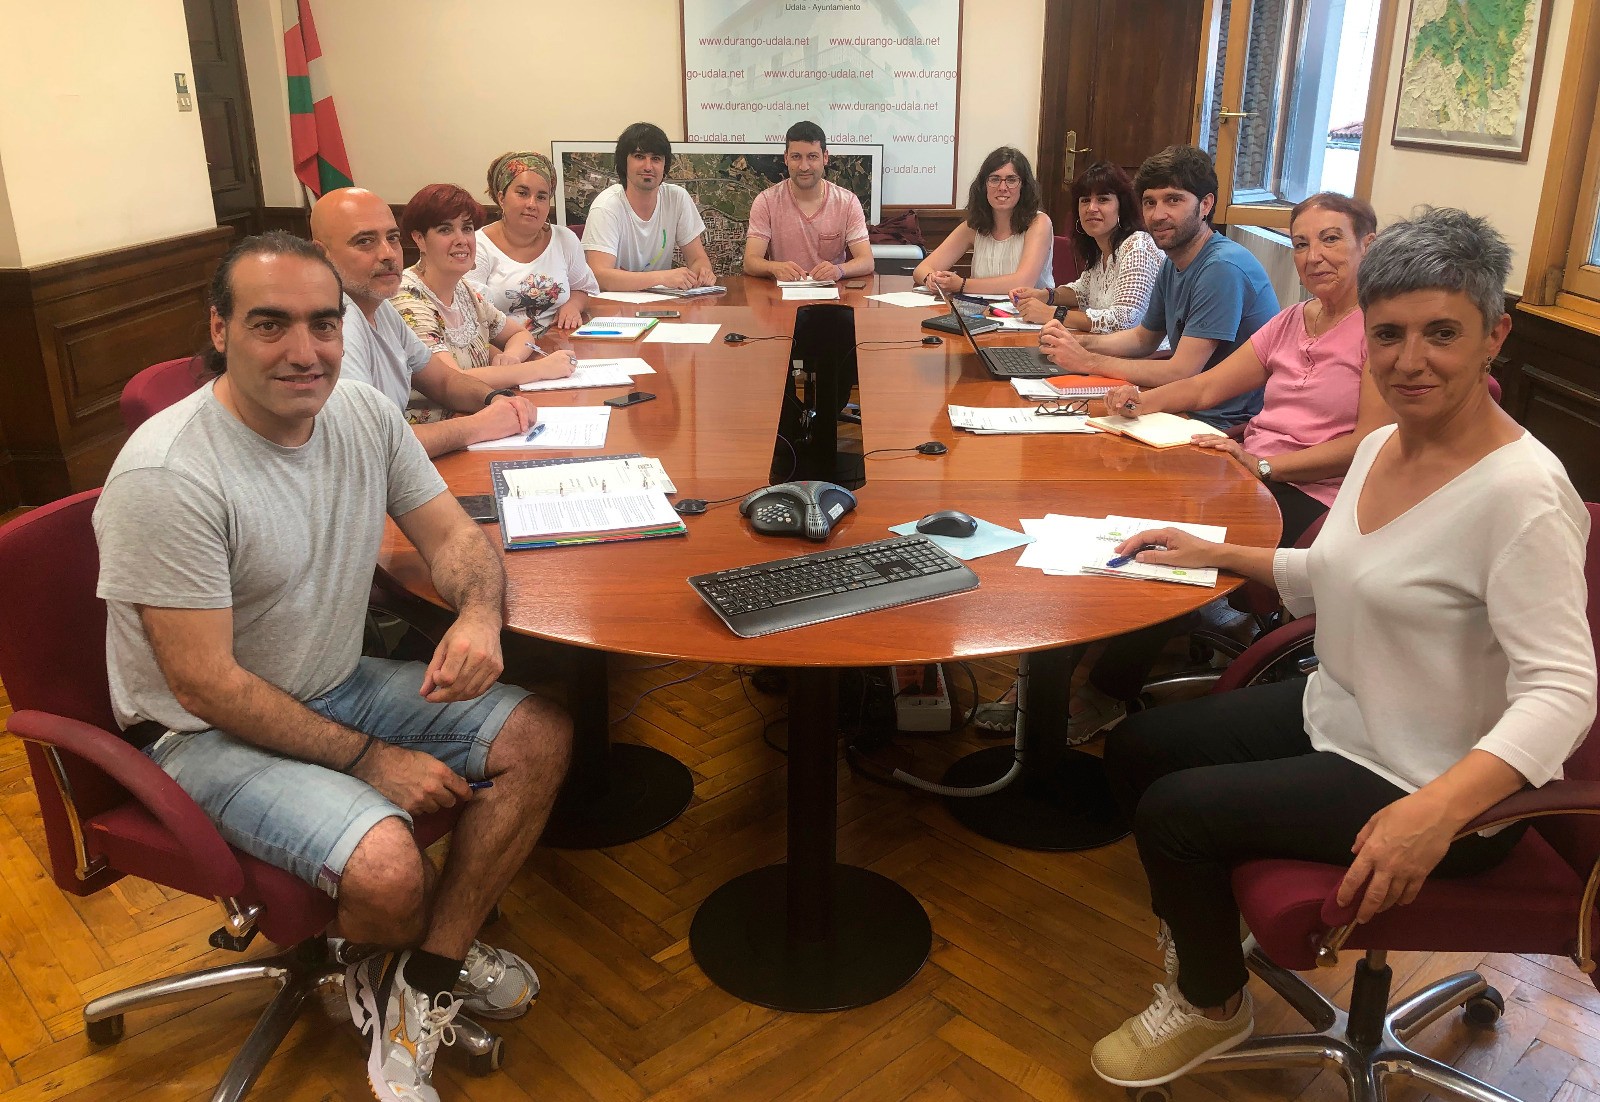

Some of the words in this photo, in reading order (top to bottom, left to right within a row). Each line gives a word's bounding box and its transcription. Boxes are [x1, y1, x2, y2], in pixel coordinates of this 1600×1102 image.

[812, 4, 861, 13] Ayuntamiento
[699, 36, 810, 48] www.durango-udala.net
[829, 36, 940, 48] www.durango-udala.net
[764, 69, 874, 81] www.durango-udala.net
[700, 101, 810, 113] www.durango-udala.net
[829, 101, 938, 113] www.durango-udala.net
